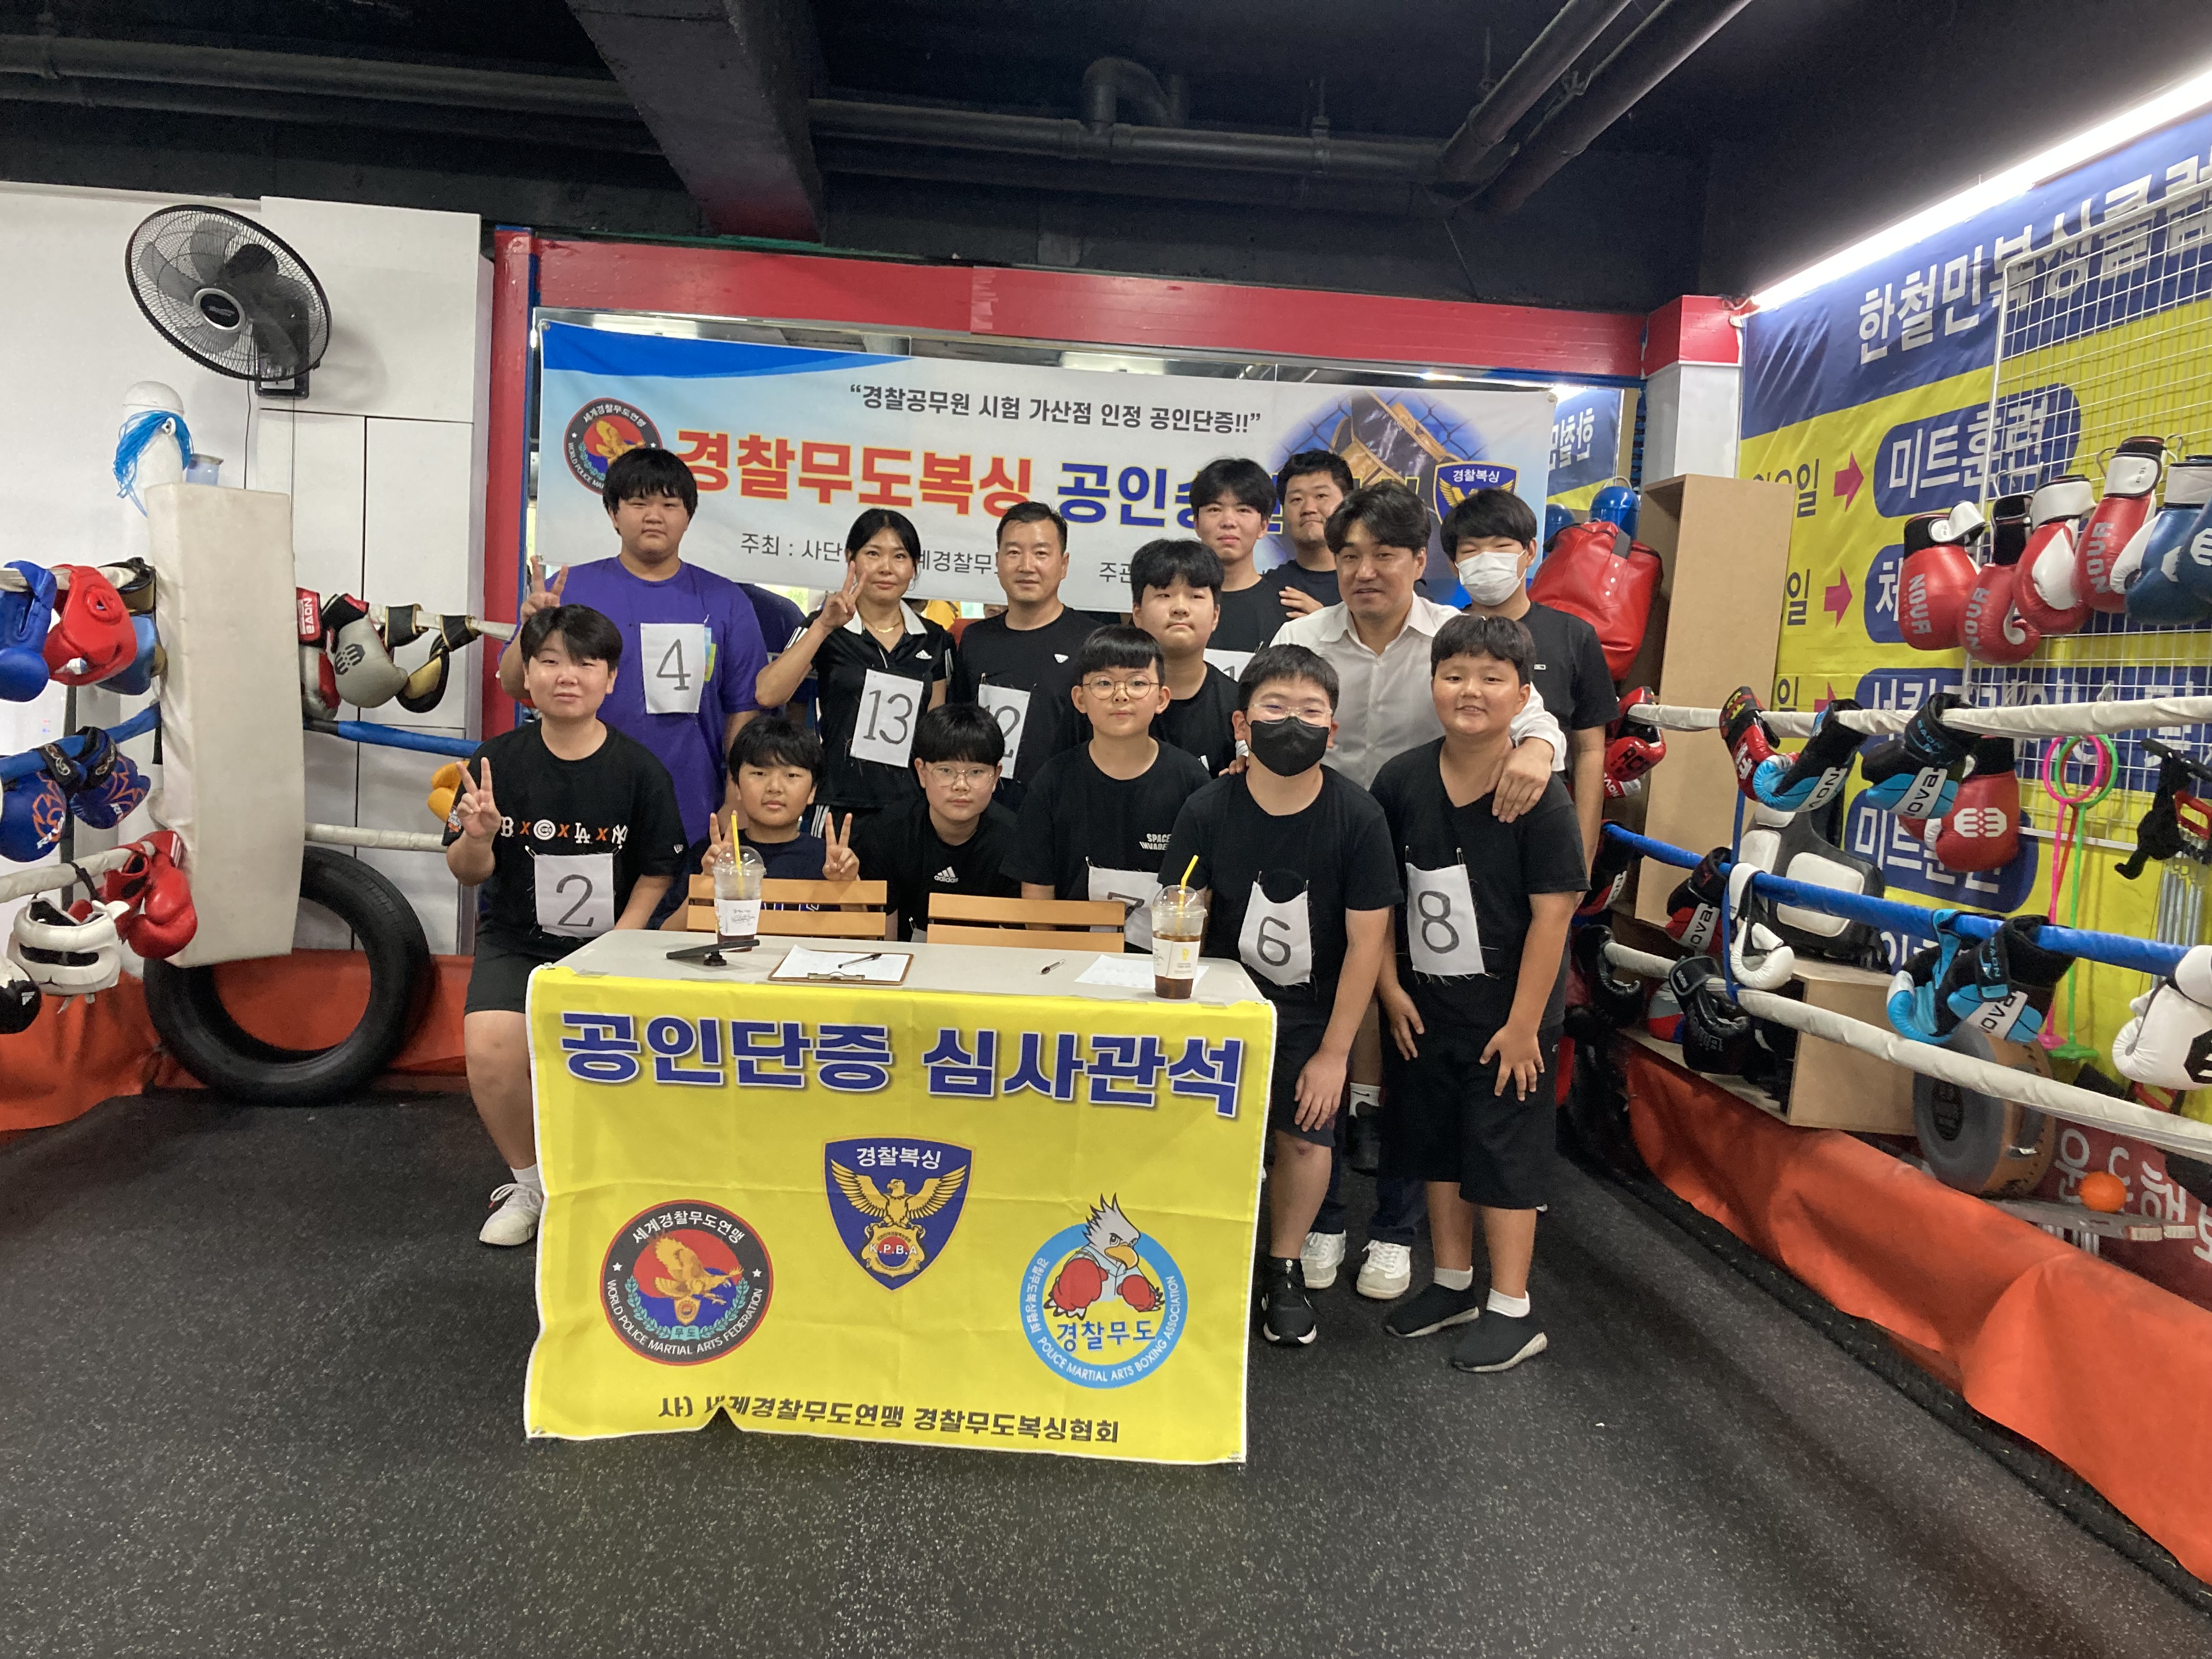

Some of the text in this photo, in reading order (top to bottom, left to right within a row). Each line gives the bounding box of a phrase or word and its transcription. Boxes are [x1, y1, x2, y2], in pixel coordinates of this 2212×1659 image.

[979, 394, 1020, 420] 시험
[1029, 399, 1092, 425] 가산점
[1101, 403, 1141, 428] 인정
[676, 430, 1032, 518] 경찰무도복싱
[1453, 469, 1500, 483] 경찰복싱
[741, 533, 779, 556] 주최
[656, 639, 691, 691] 4
[862, 690, 913, 745] 13
[500, 816, 515, 837] B
[574, 823, 591, 844] LA
[612, 824, 628, 844] NY
[1139, 841, 1169, 851] INVADE
[1146, 833, 1172, 843] SPACE
[934, 875, 959, 883] adidas
[556, 874, 595, 927] 2
[1418, 890, 1459, 954] 8
[1256, 916, 1291, 967] 6
[560, 1011, 1244, 1118] 공인단증 심사관석
[856, 1146, 941, 1170] 경찰복싱
[633, 1210, 746, 1244] 세계경찰무도연맹
[870, 1243, 918, 1255] K.P.B.A
[607, 1279, 763, 1355] WORLD POLICE MARTIAL ARTS FEDERATION
[675, 1329, 696, 1338] 무도
[1037, 1276, 1181, 1382] POLICE MARTIAL ARTS BOXING ASSOCIATION
[1057, 1320, 1156, 1352] 경찰무도
[915, 1406, 1119, 1443] 경찰무도복싱협회
